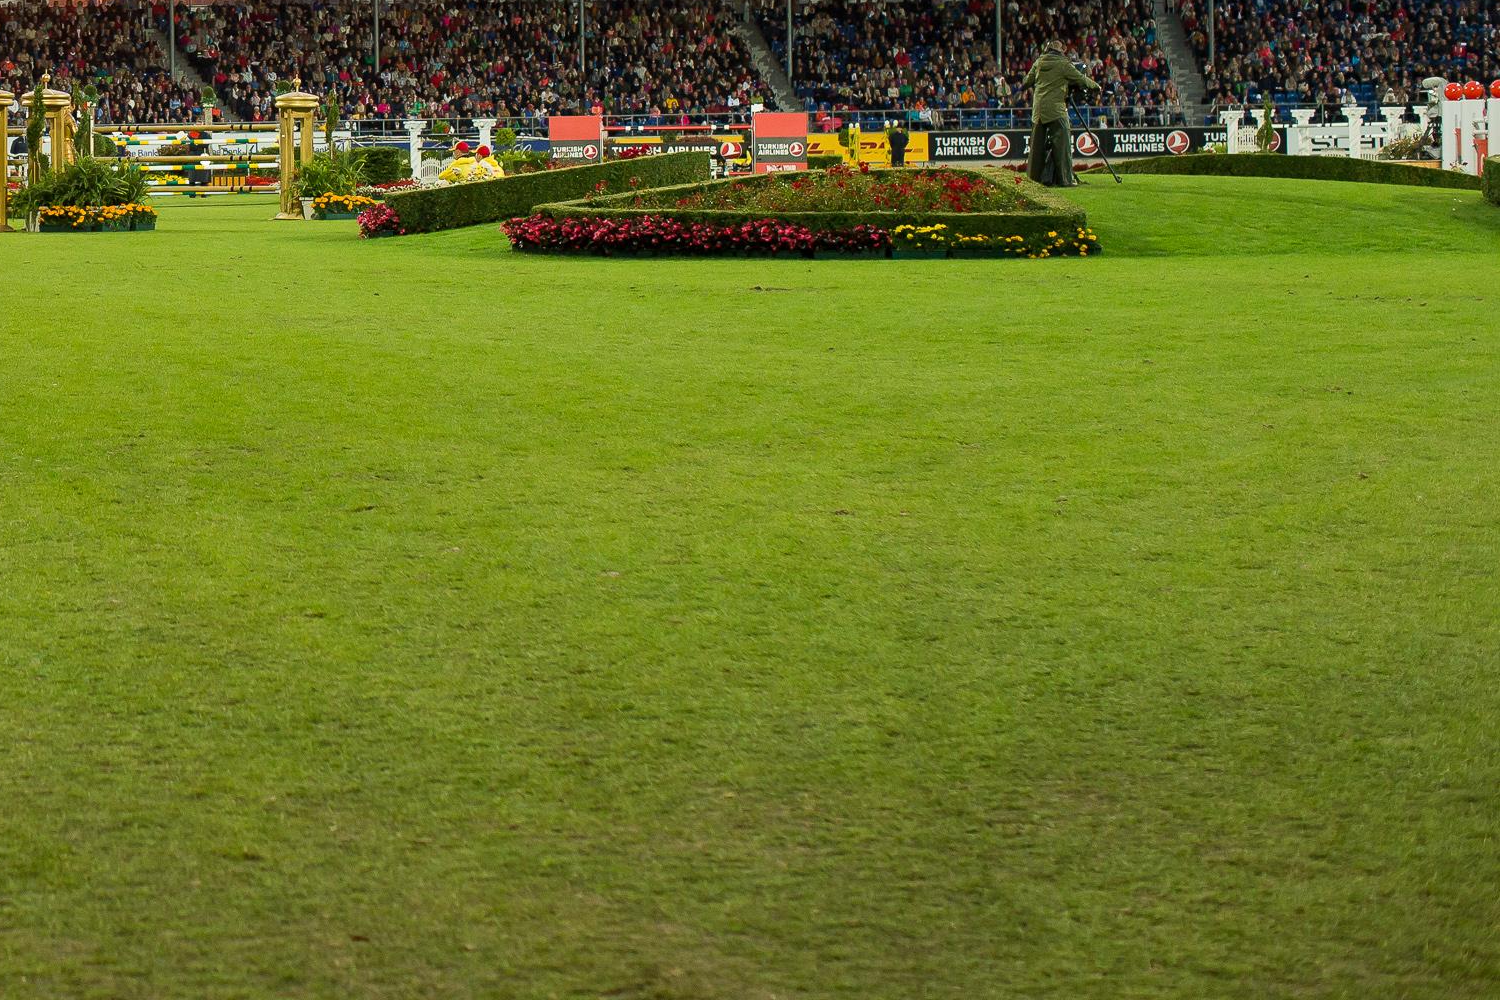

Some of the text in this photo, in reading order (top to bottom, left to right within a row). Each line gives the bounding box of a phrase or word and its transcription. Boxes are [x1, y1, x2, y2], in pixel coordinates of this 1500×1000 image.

[935, 136, 985, 146] TURKISH
[1113, 133, 1165, 143] TURKISH
[935, 146, 986, 156] AIRLINES
[1113, 143, 1165, 153] AIRLINES
